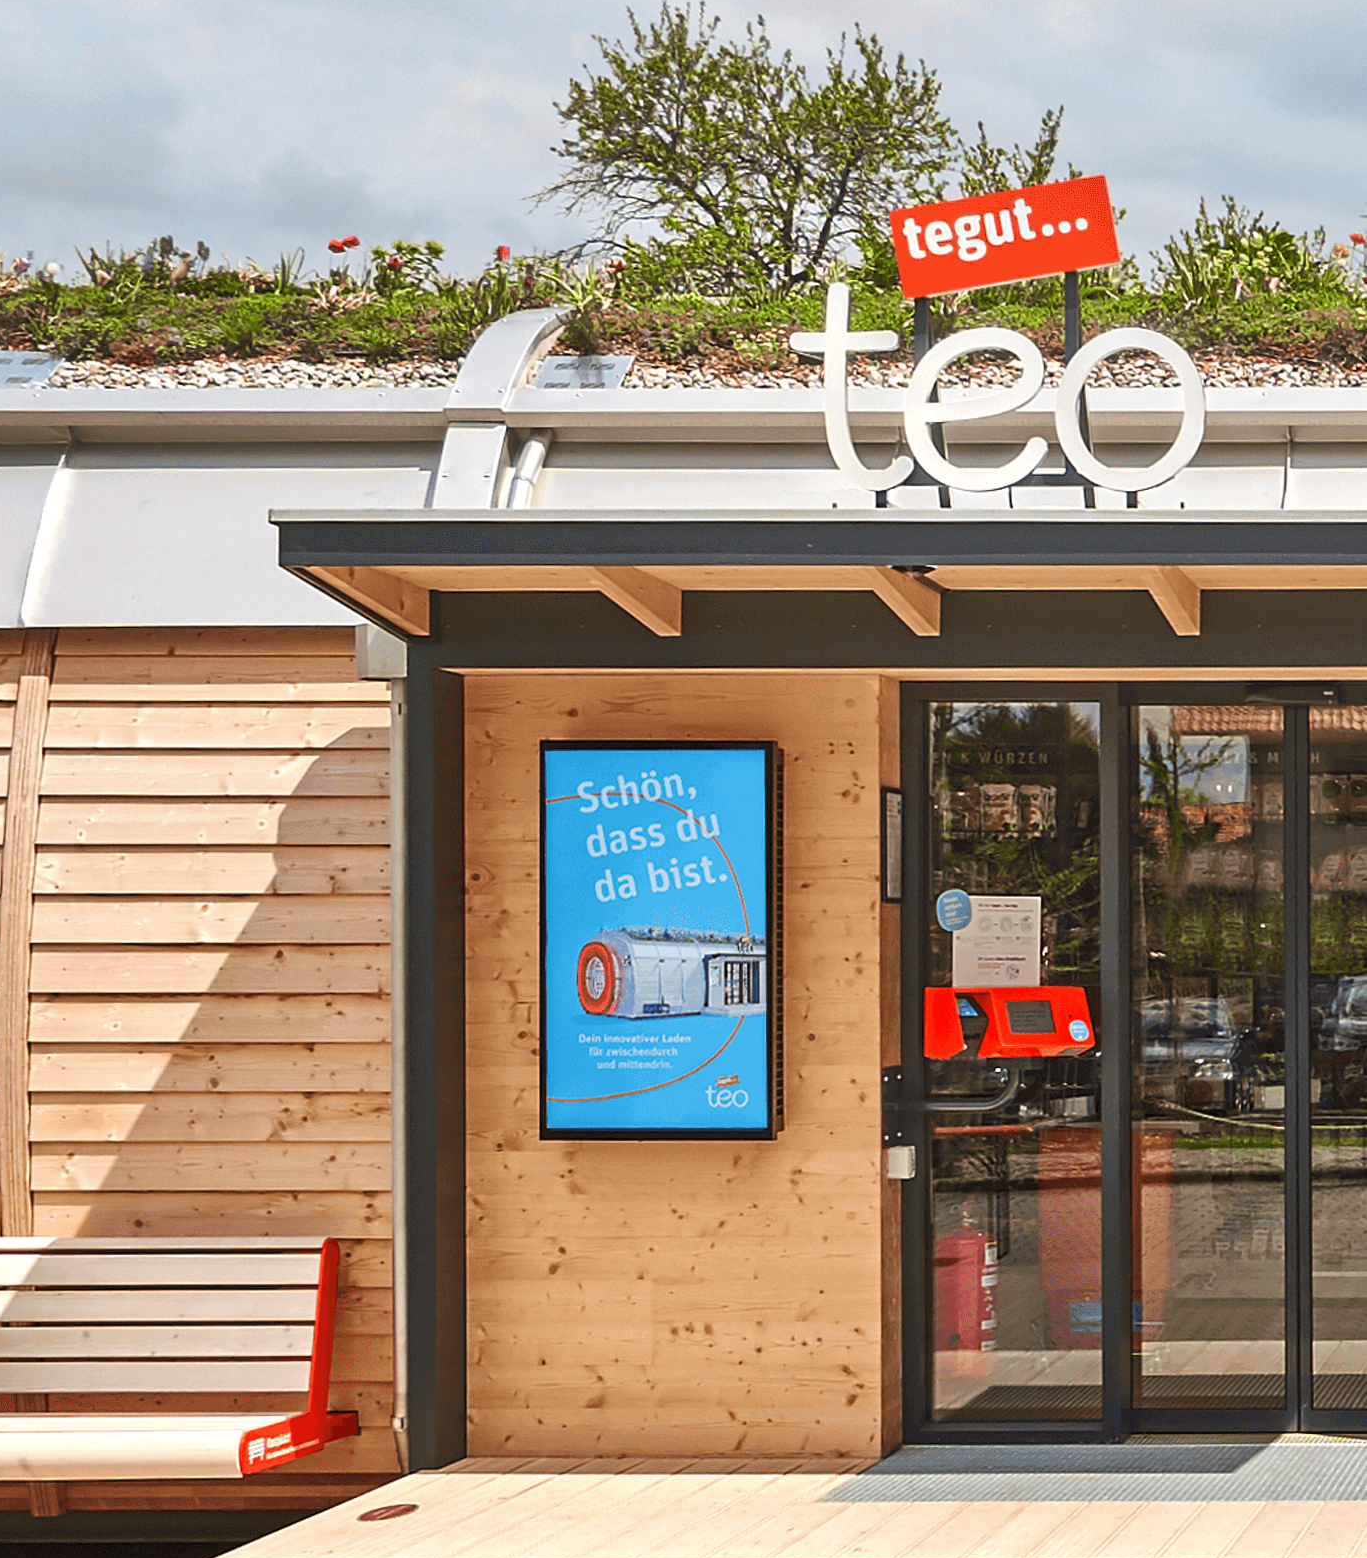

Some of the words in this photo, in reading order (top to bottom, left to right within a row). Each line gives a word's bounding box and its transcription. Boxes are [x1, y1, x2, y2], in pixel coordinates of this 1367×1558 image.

[902, 198, 1089, 262] tegut...
[789, 283, 1206, 492] teo
[978, 749, 1049, 765] WÜRZEN
[577, 770, 697, 813] Schön,
[586, 824, 666, 858] dass
[676, 809, 721, 843] du
[595, 869, 637, 903] da
[647, 855, 728, 894] bist.
[578, 1033, 601, 1044] Dein
[603, 1033, 660, 1044] innovativer
[662, 1033, 692, 1044] Laden
[588, 1046, 603, 1057] für
[606, 1046, 679, 1057] zwischendurch
[596, 1060, 616, 1070] und
[704, 1085, 750, 1109] teo
